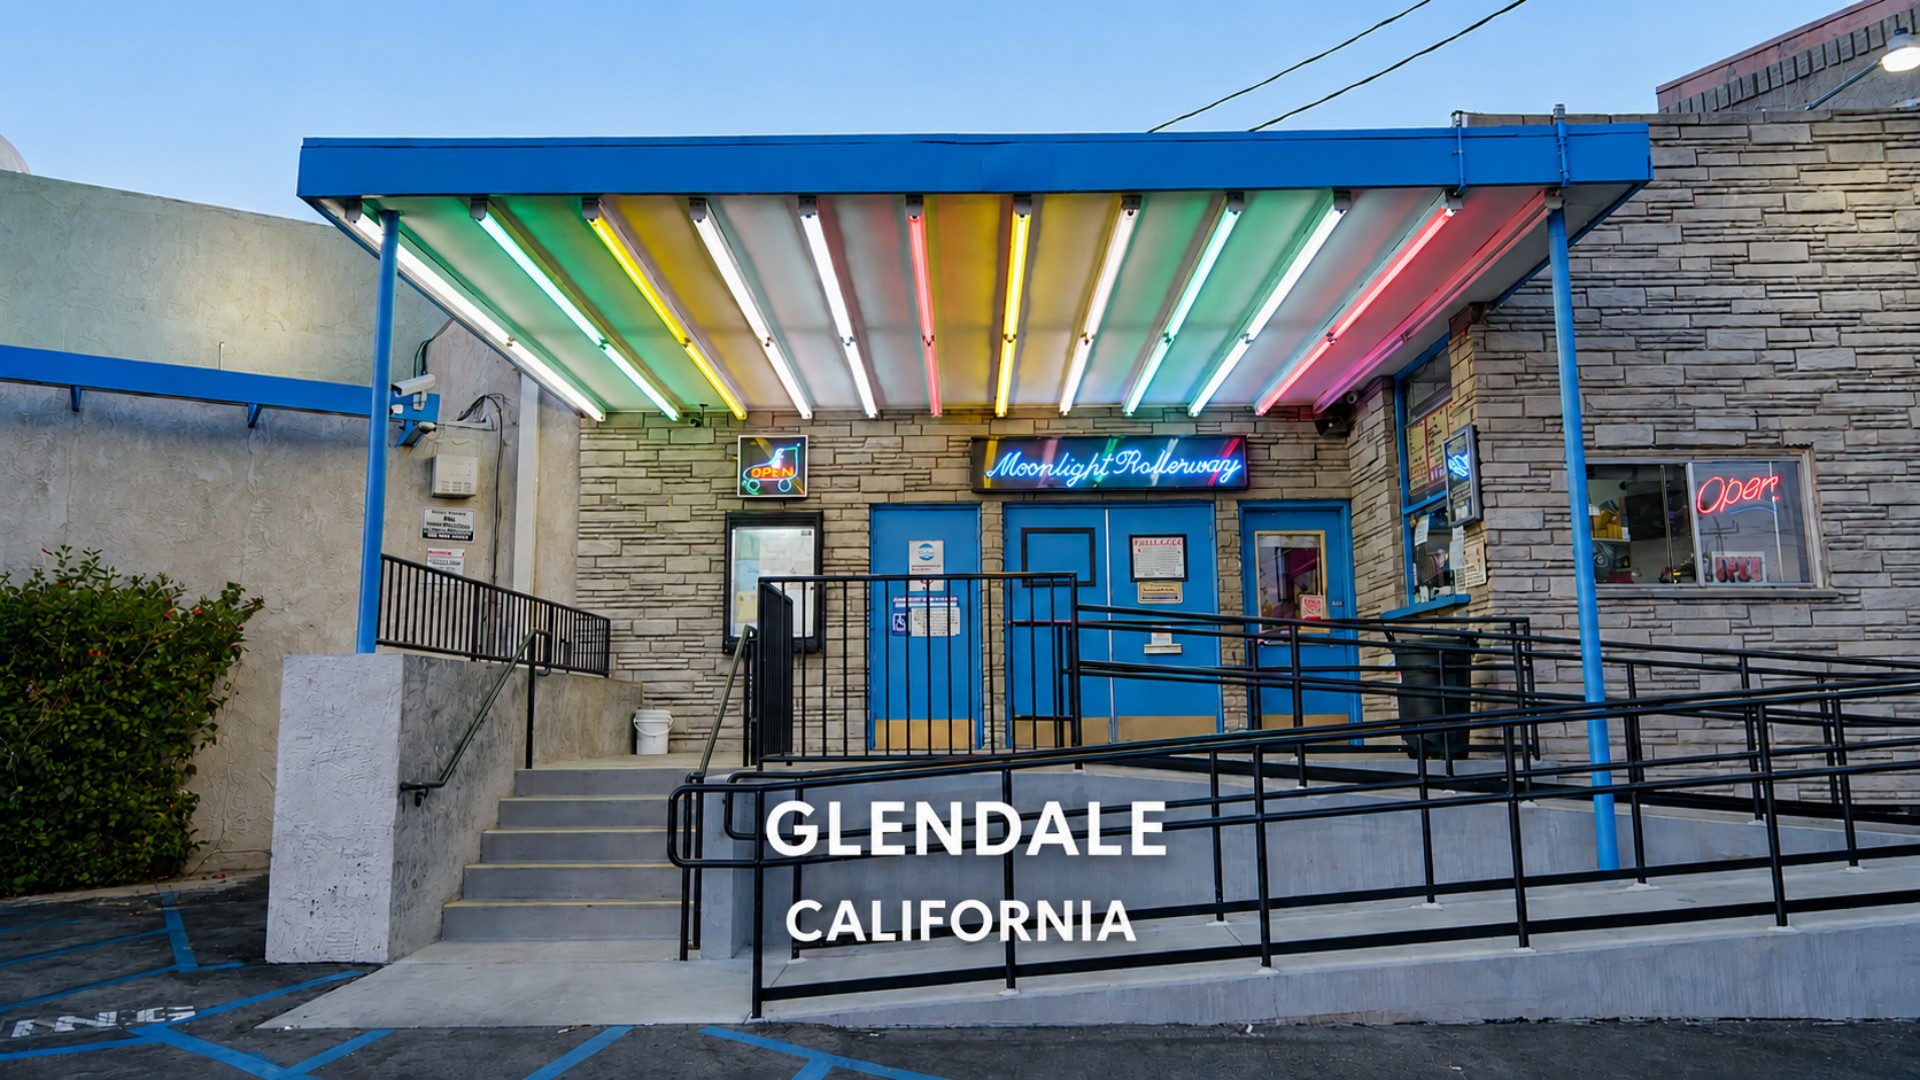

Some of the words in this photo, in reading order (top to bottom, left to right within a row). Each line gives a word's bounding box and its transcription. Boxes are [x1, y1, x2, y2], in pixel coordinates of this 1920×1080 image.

[750, 466, 795, 478] OPEN
[986, 451, 1115, 488] Moonlight
[1113, 449, 1242, 483] Rollerway
[1697, 476, 1780, 514] Open
